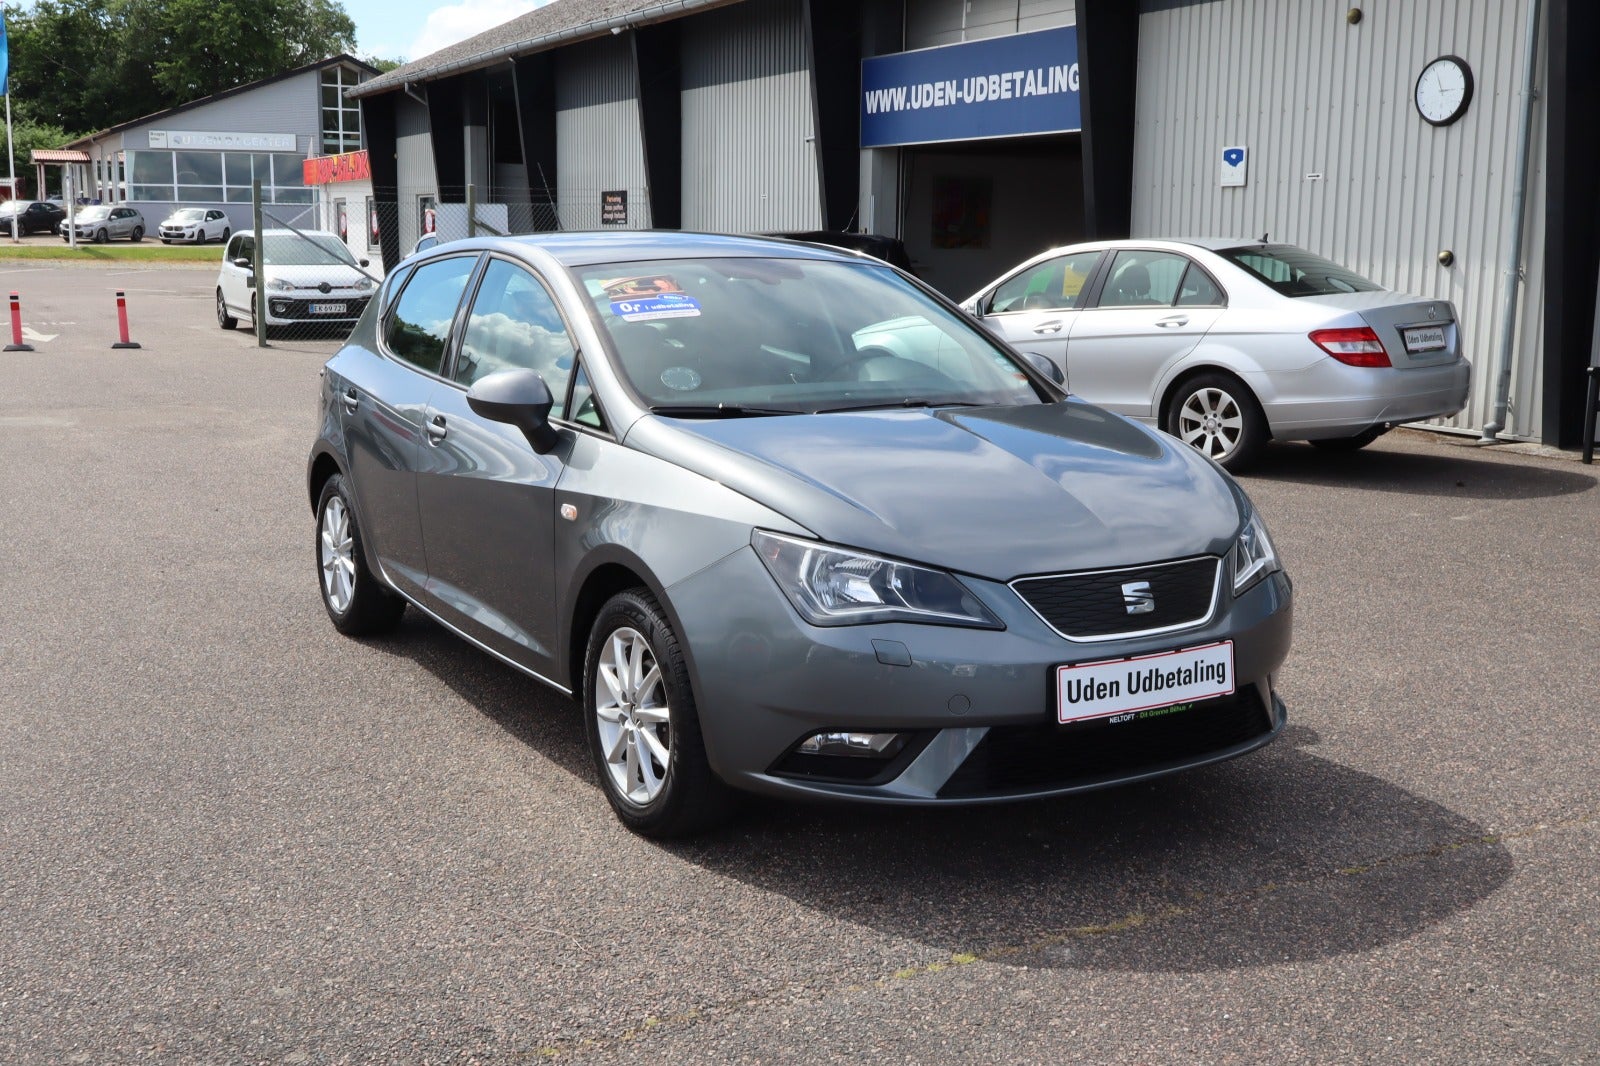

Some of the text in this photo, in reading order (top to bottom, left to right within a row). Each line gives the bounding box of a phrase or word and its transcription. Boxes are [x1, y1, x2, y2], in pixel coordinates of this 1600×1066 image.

[1067, 659, 1226, 704] Uden Udbetaling
[1109, 713, 1135, 724] NELTOFT
